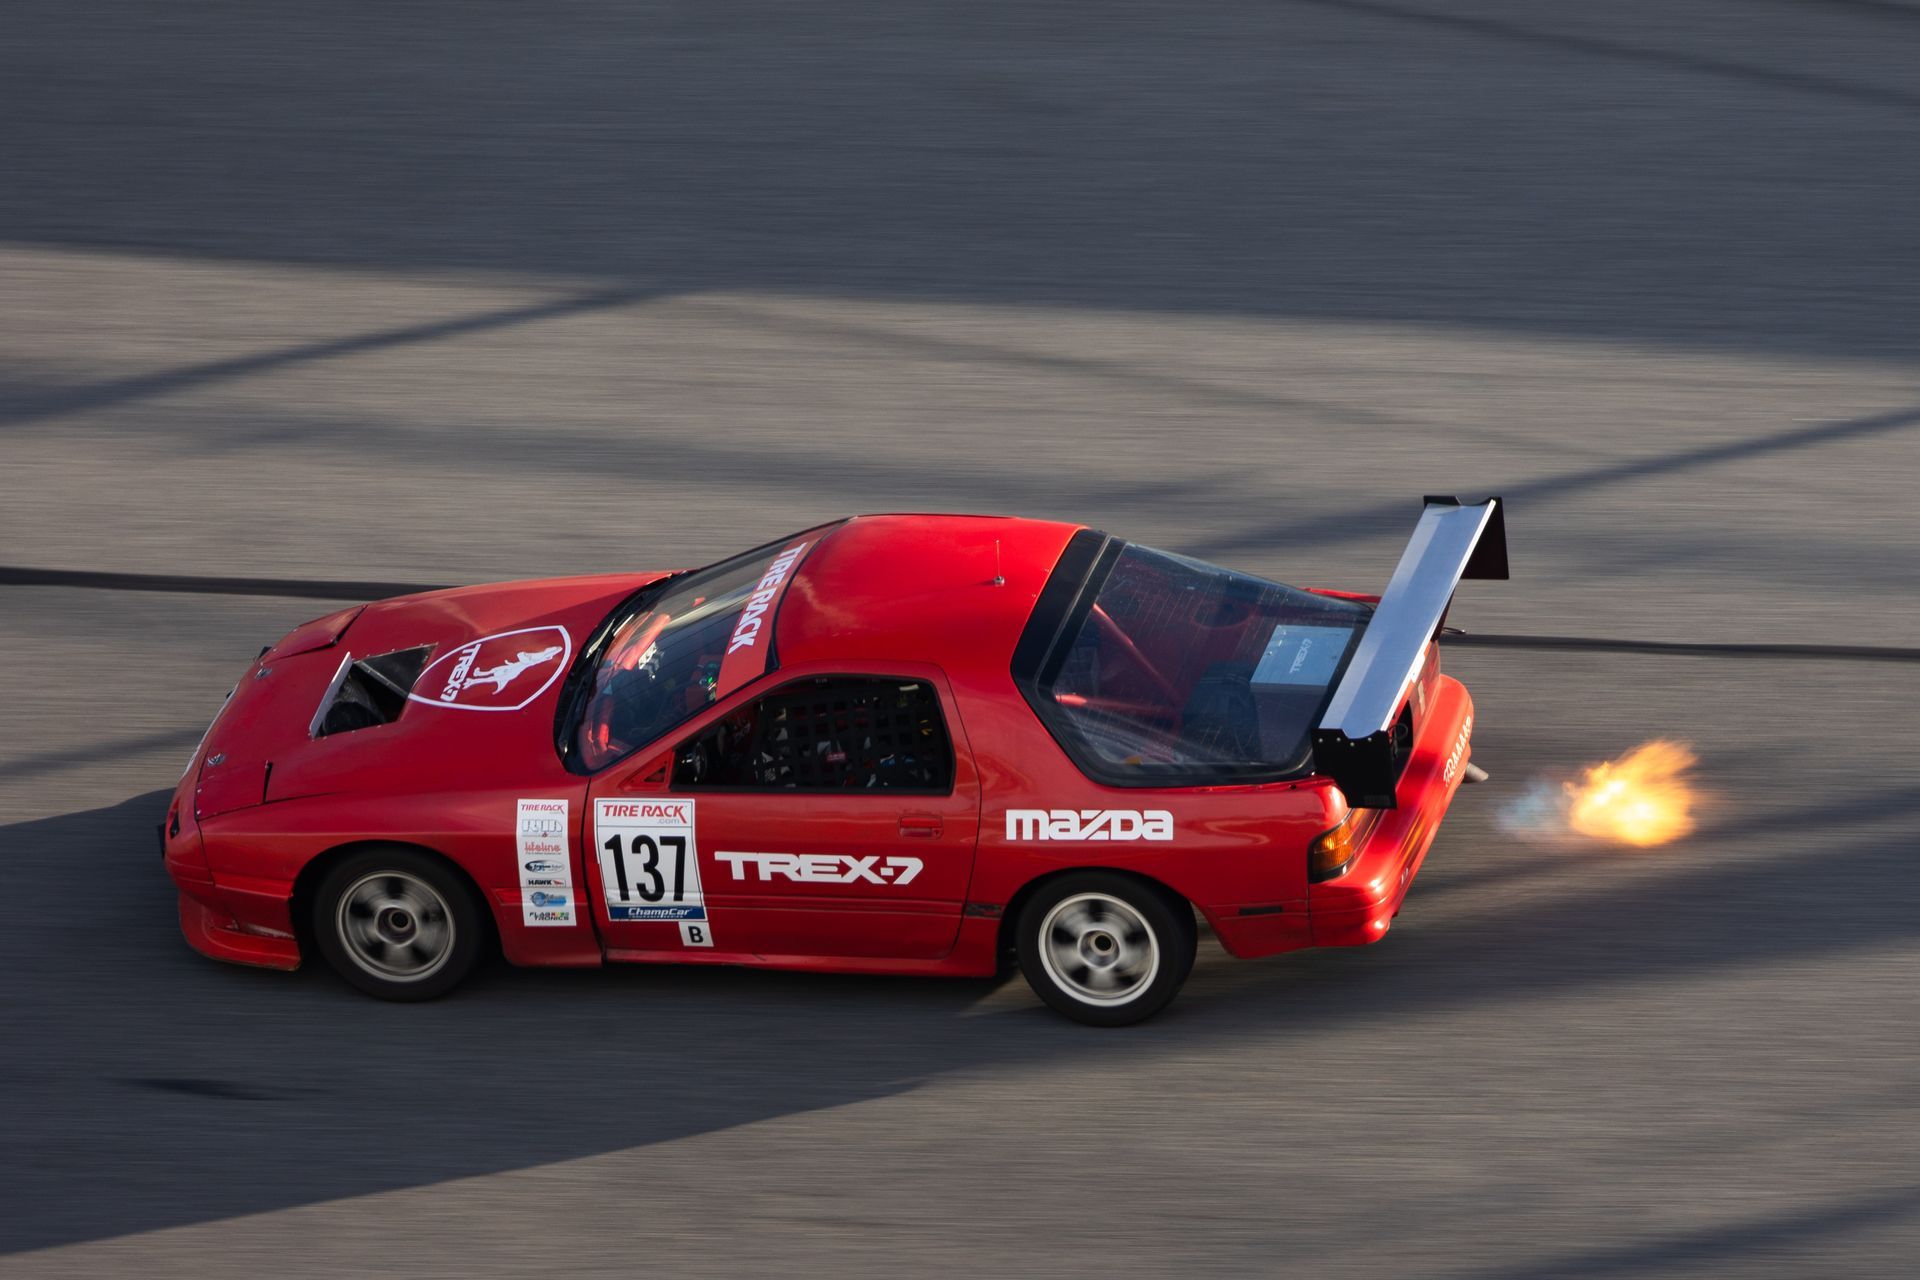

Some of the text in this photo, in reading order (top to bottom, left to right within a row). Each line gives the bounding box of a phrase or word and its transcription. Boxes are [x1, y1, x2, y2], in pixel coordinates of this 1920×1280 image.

[727, 542, 808, 655] TIRE RACK
[440, 643, 482, 701] TREX-7
[520, 804, 539, 812] TIRE
[540, 804, 565, 815] RACK
[603, 805, 687, 824] TIRE RACK
[657, 817, 680, 825] .com
[604, 834, 686, 902] 137
[714, 851, 924, 885] TREX-7
[628, 907, 691, 919] ChampCar
[688, 926, 704, 944] B
